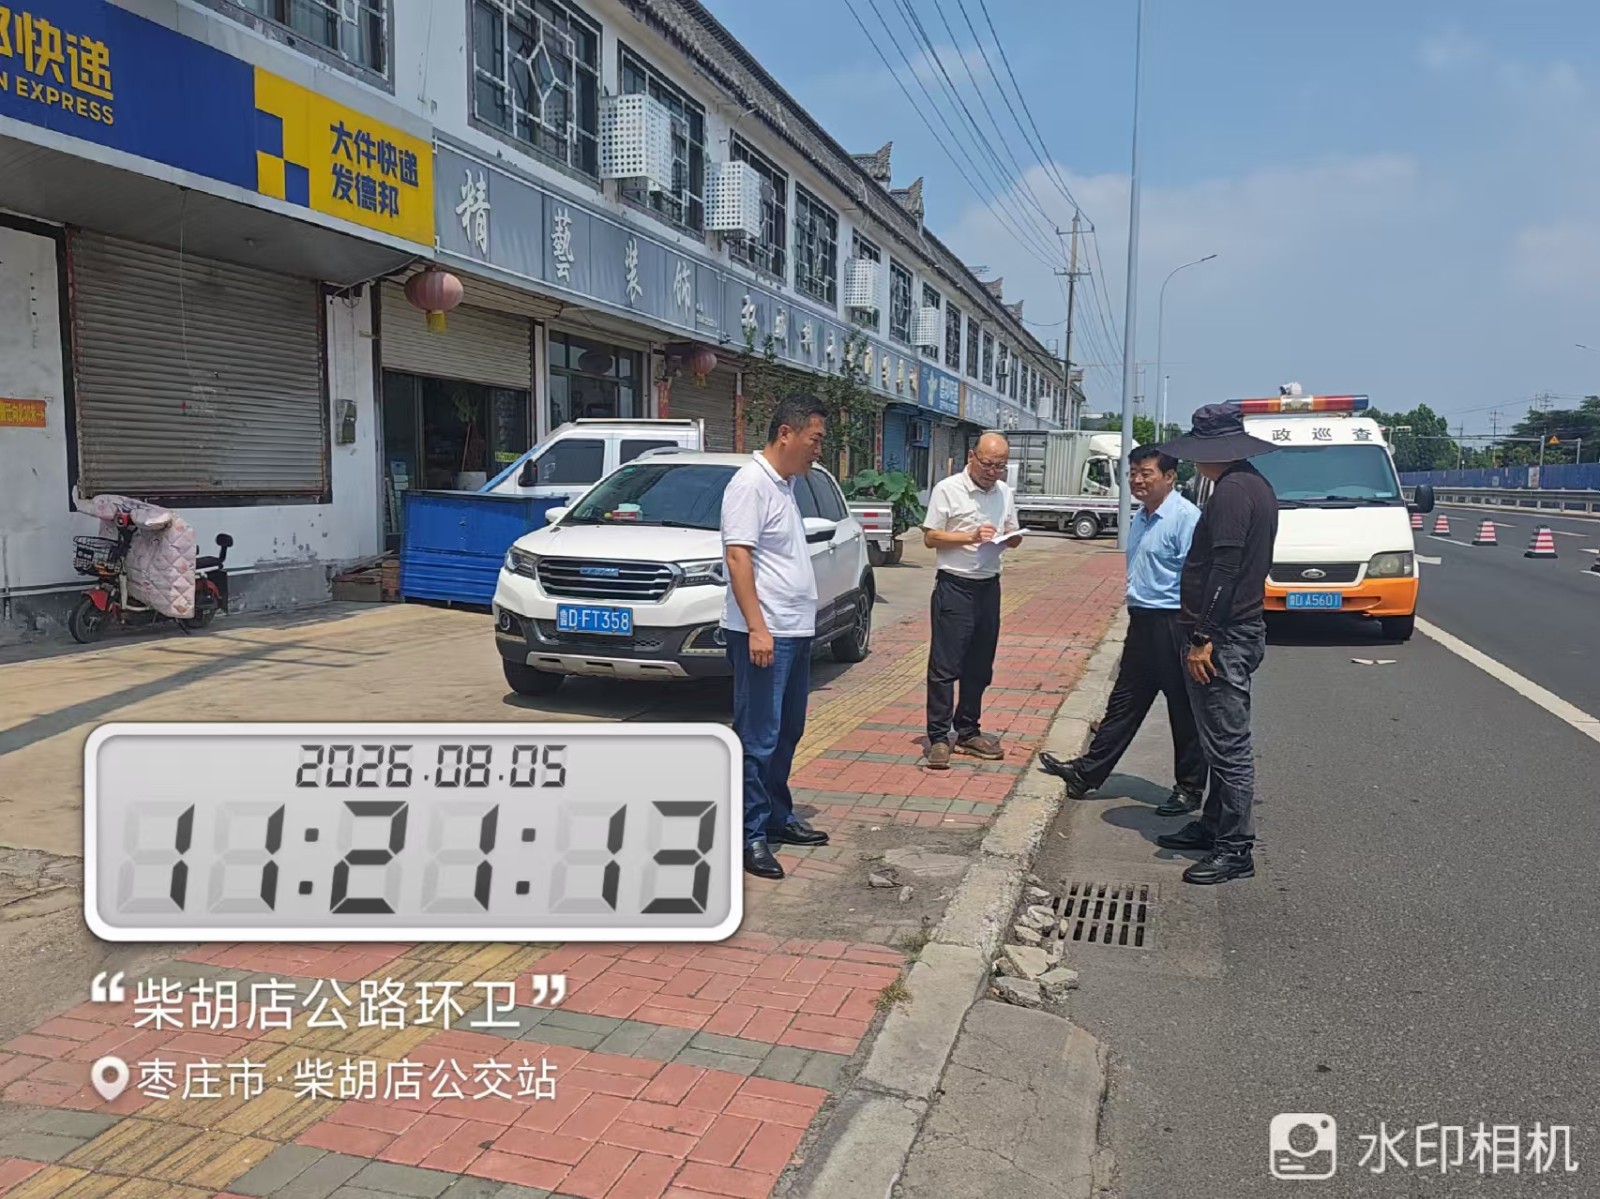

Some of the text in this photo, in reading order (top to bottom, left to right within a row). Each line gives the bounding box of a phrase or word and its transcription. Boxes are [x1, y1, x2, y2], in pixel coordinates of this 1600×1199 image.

[16, 75, 114, 126] EXPRESS
[330, 120, 419, 188] 大件快递
[331, 162, 400, 218] 发德邦
[1245, 427, 1373, 442] 政巡查
